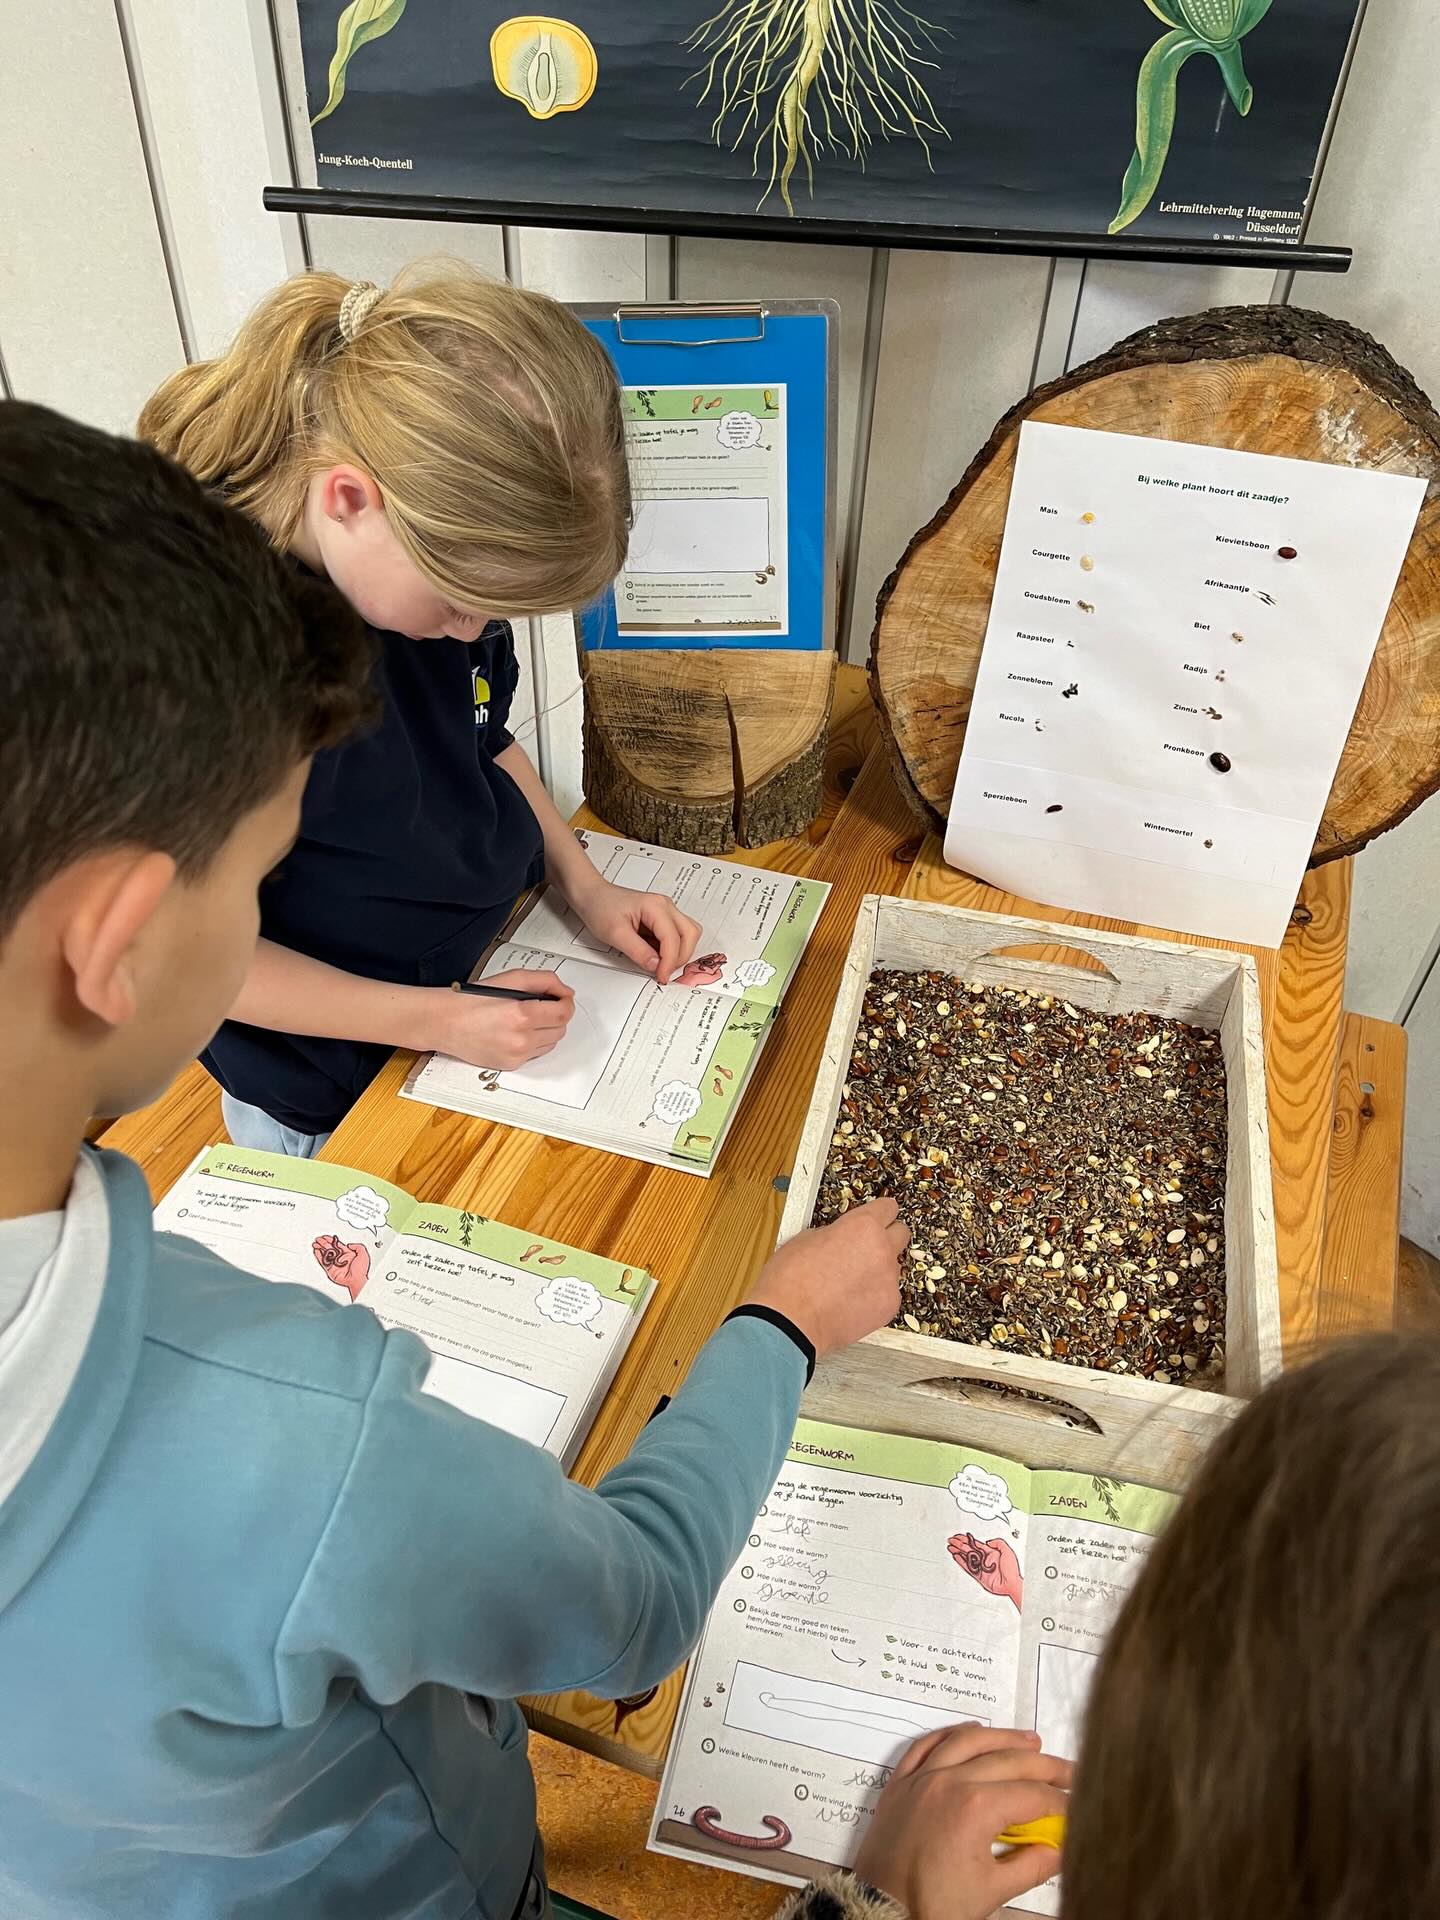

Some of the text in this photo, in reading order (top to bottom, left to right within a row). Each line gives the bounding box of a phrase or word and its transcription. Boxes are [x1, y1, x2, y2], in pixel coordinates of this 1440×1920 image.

[318, 153, 413, 169] Jung-Koch-Quentell
[1160, 202, 1243, 218] Lehrmittelverlag
[1246, 222, 1300, 235] Düsseldorf
[1138, 475, 1150, 484] Bij
[1153, 479, 1180, 488] welke
[1182, 483, 1206, 491] plant
[1209, 486, 1234, 496] hoort
[1252, 493, 1289, 504] zaadje?
[1040, 506, 1058, 514] Mais
[1215, 535, 1270, 550] Kievietsboon
[1032, 549, 1070, 561] Courgette
[1204, 580, 1250, 593] Afrikaantje
[1024, 591, 1071, 605] Goudsbloem
[1194, 622, 1210, 630] Biet
[1016, 632, 1054, 643] Raapsteel
[1183, 664, 1208, 674] Radijs
[1007, 673, 1053, 686] Zonnebloem
[1173, 703, 1198, 714] Zinnia
[999, 713, 1025, 723] Rucola
[1163, 744, 1205, 757] Pronkboon
[983, 791, 1028, 805] Sperzieboon
[1144, 822, 1193, 838] Winterwortel
[227, 1164, 274, 1178] REGENWORM
[418, 1221, 448, 1234] ZADEN
[401, 1249, 421, 1257] Orden
[435, 1256, 455, 1266] zaden
[457, 1263, 465, 1271] op
[468, 1264, 488, 1276] tafel
[500, 1275, 514, 1286] mag
[407, 1259, 422, 1267] zelf
[424, 1262, 446, 1272] kiezen
[774, 1491, 844, 1508] op je hand leggen
[778, 1481, 795, 1492] mag
[811, 1485, 856, 1496] regenworm
[859, 1490, 903, 1506] voorzichtig
[1049, 1495, 1088, 1509] ZADEN
[770, 1510, 786, 1518] Geef
[797, 1516, 815, 1525] worm
[1047, 1534, 1073, 1543] Orden
[1075, 1537, 1086, 1545] de
[1089, 1538, 1115, 1550] zaden
[806, 1551, 828, 1559] worm?
[1058, 1546, 1129, 1563] zelf kiezen hoe!
[771, 1576, 787, 1584] ruikt
[798, 1583, 821, 1591] worm?
[1061, 1572, 1075, 1580] Hoe
[1076, 1575, 1089, 1583] heb
[749, 1606, 769, 1615] Bekijk
[781, 1614, 800, 1623] worm
[801, 1619, 819, 1628] goed
[830, 1625, 849, 1634] teken
[748, 1615, 781, 1627] hem/haar
[807, 1629, 828, 1640] hierbij
[840, 1636, 856, 1645] deze
[900, 1639, 924, 1649] Voor-
[942, 1648, 993, 1664] achterkant
[898, 1656, 928, 1669] De huid
[950, 1666, 986, 1681] De vorm
[895, 1673, 997, 1703] De ringen (segmenten)
[719, 1746, 740, 1758] Welke
[741, 1752, 768, 1766] kleuren
[769, 1760, 789, 1772] heeft
[790, 1765, 800, 1774] de
[801, 1768, 826, 1780] worm?
[812, 1792, 827, 1802] Wat
[829, 1798, 844, 1808] vind
[844, 1801, 853, 1810] je
[854, 1805, 869, 1814] van
[673, 1805, 685, 1817] 26
